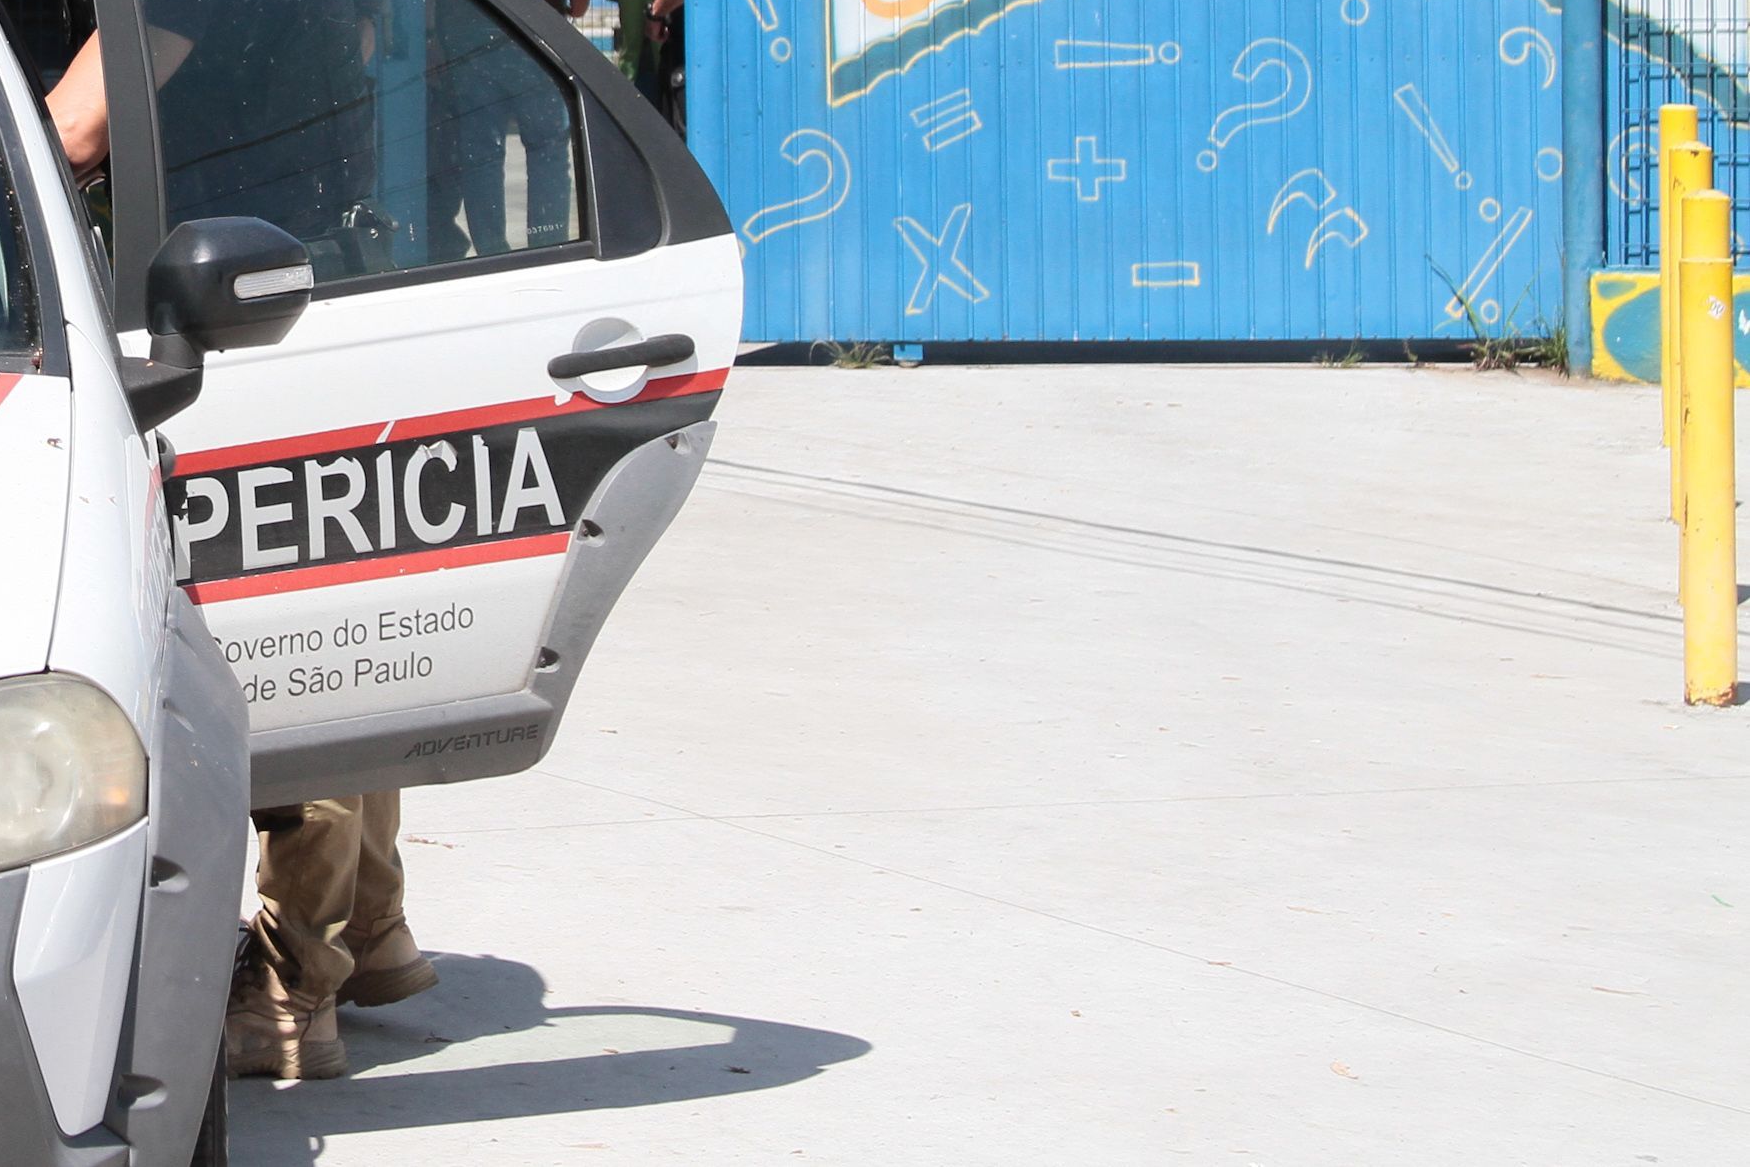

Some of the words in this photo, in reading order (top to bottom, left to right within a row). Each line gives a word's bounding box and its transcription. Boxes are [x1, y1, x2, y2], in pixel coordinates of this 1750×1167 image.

[172, 420, 567, 581] PERÍCIA
[333, 618, 368, 648] do
[378, 602, 474, 642] Estado
[242, 674, 277, 704] de
[287, 665, 343, 697] São
[353, 650, 433, 688] Paulo
[403, 723, 539, 760] ADVENTURE
